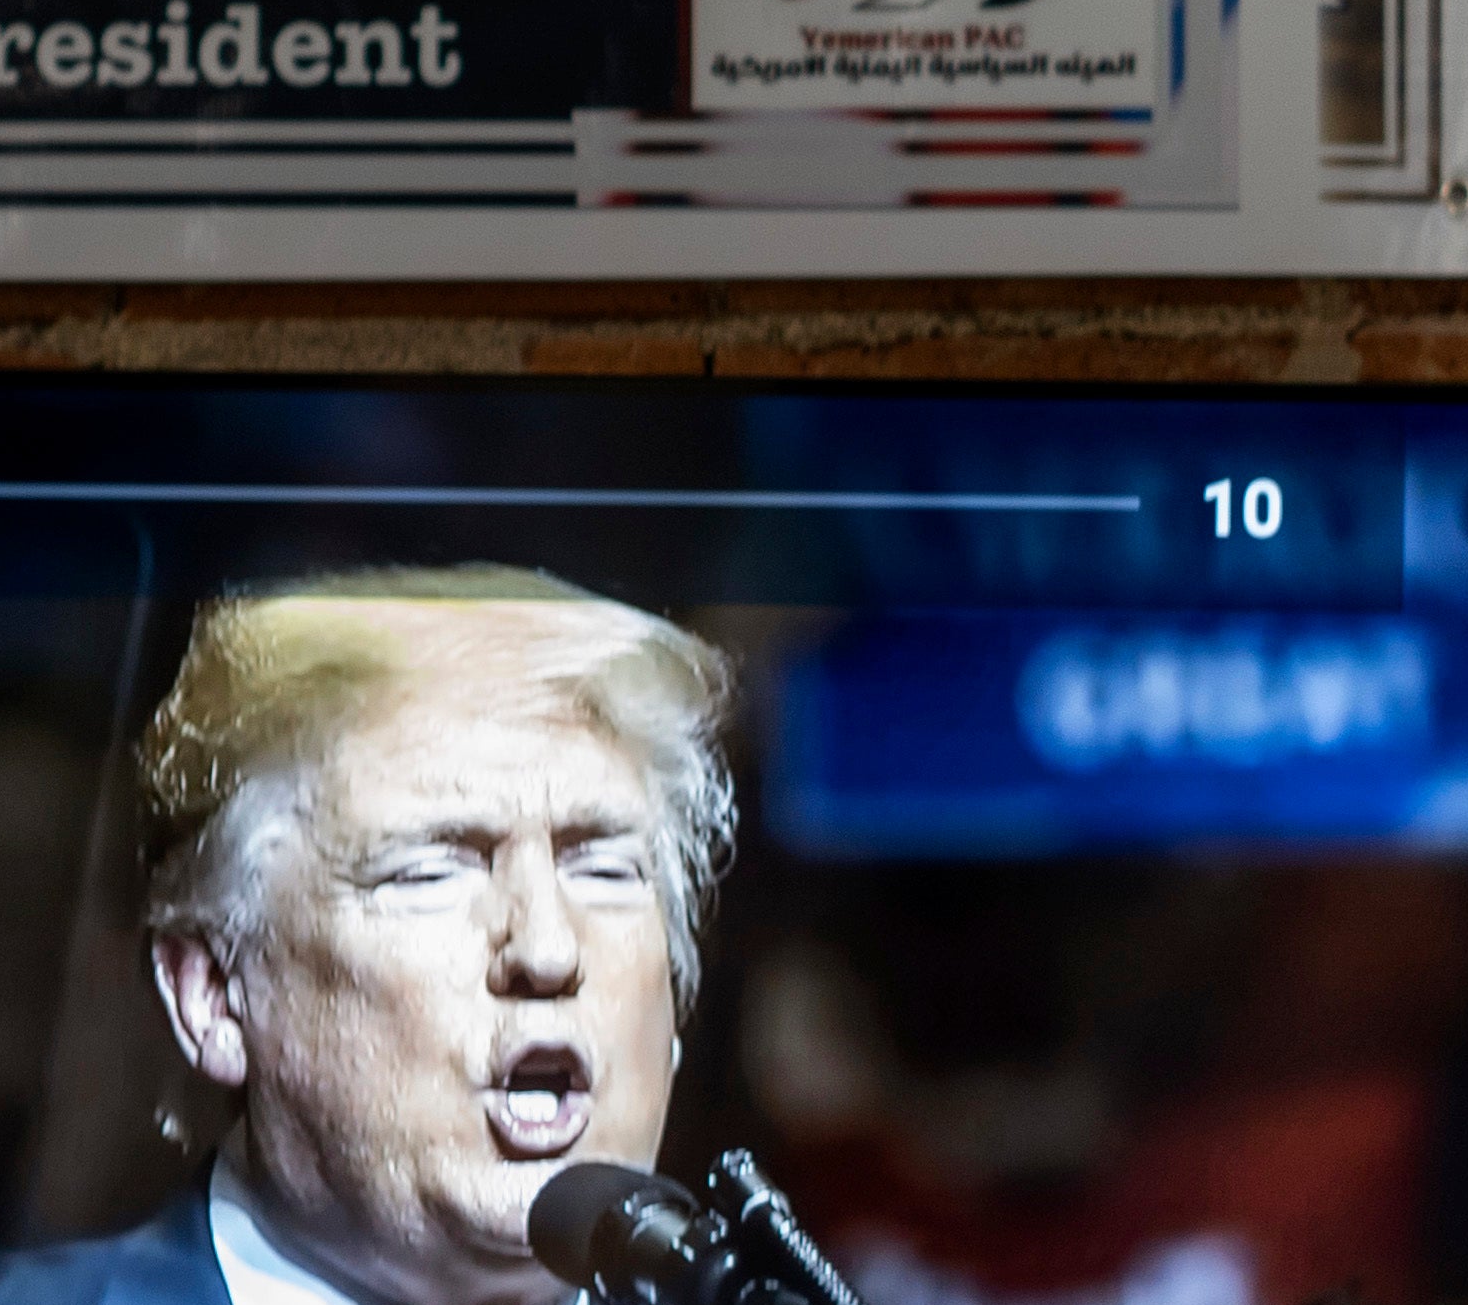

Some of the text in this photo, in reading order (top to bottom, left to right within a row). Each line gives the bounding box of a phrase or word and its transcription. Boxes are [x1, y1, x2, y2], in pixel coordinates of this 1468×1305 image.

[799, 25, 1026, 51] Yemerican PAC
[1204, 477, 1284, 539] 10
